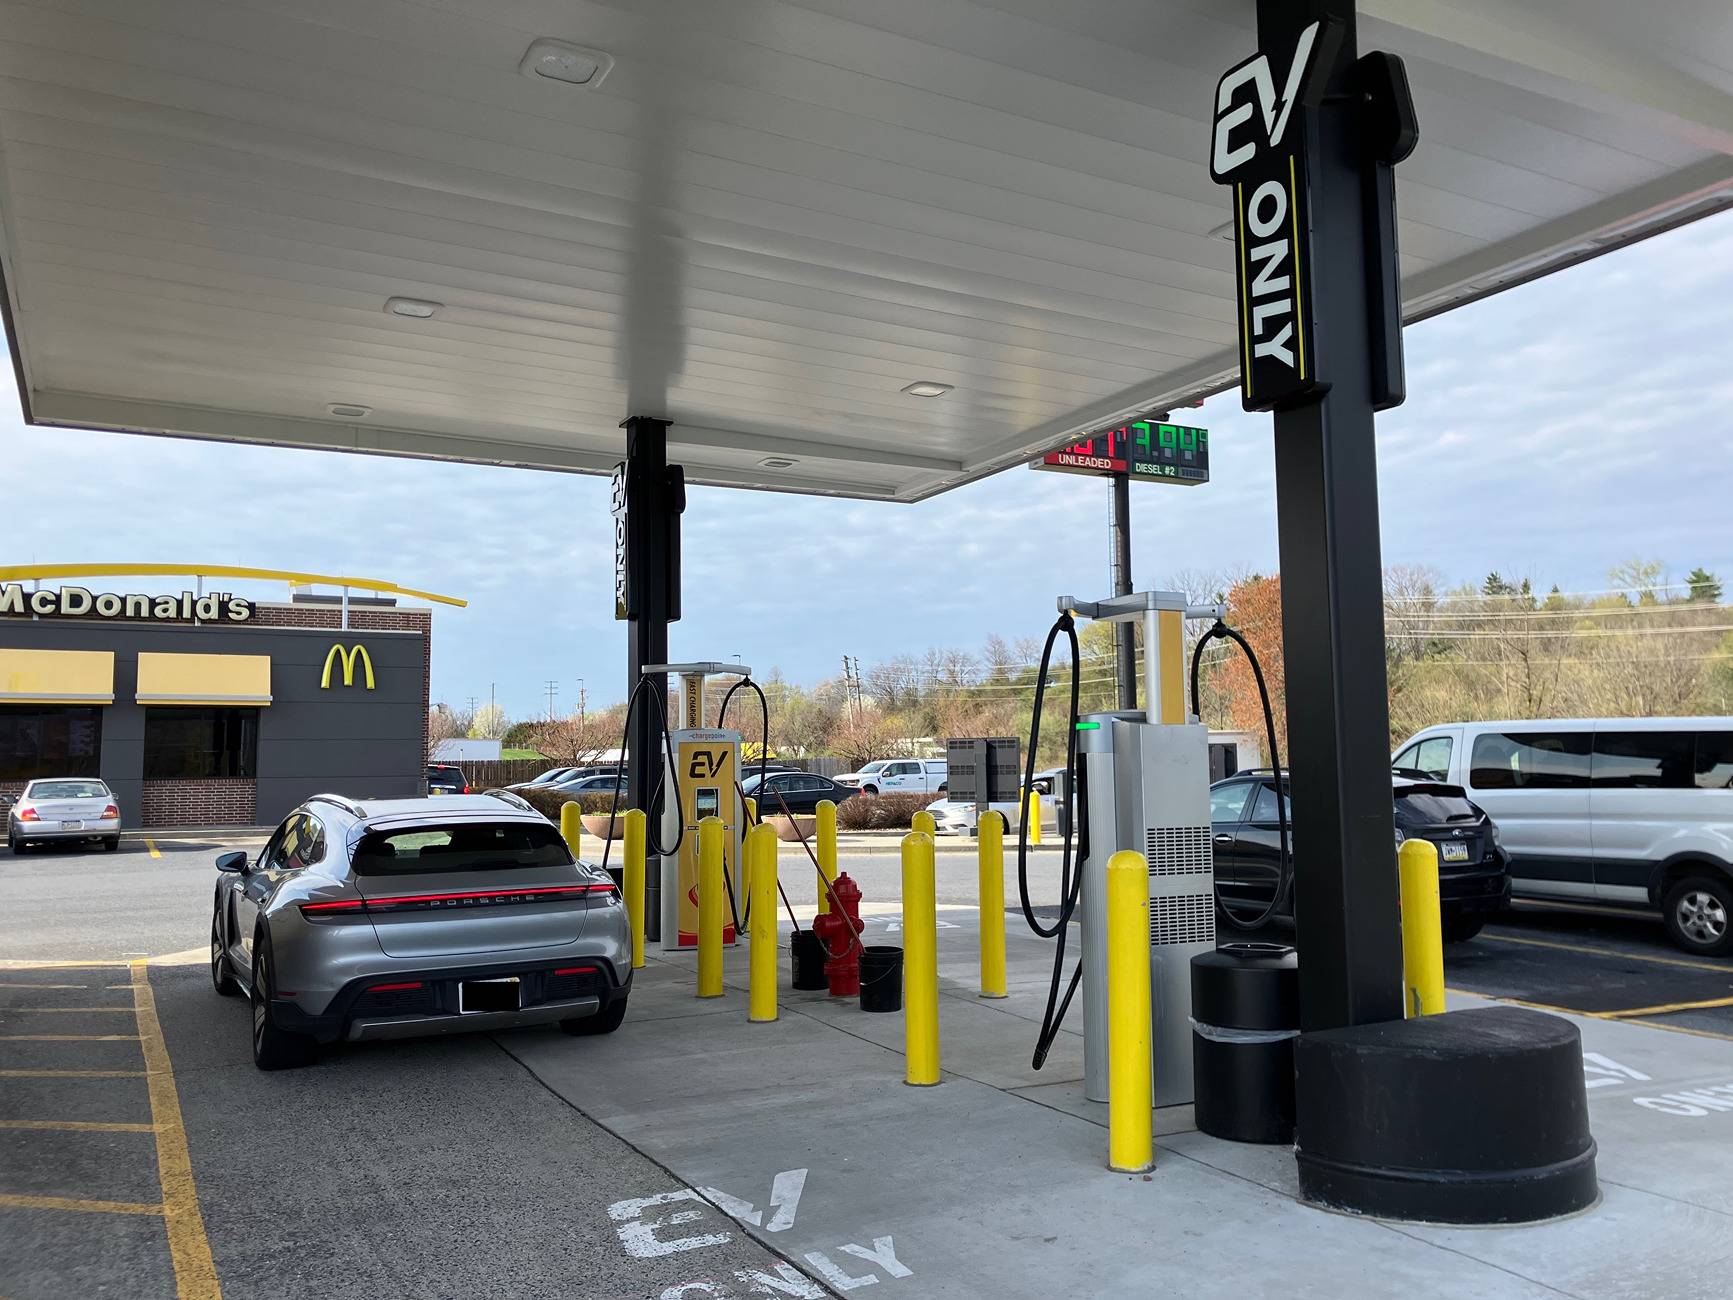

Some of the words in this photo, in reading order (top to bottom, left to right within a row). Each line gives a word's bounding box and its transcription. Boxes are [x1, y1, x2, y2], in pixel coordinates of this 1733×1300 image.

[1213, 21, 1319, 175] EV
[1248, 180, 1295, 369] ONLY
[1058, 454, 1112, 469] UNLEADED
[1135, 463, 1162, 475] DIESEL
[1164, 465, 1175, 476] #2
[0, 583, 250, 621] McDonald's
[689, 696, 697, 728] CHARGING
[689, 750, 729, 778] EV
[430, 894, 535, 906] PORSCHE
[607, 1168, 809, 1258] EV
